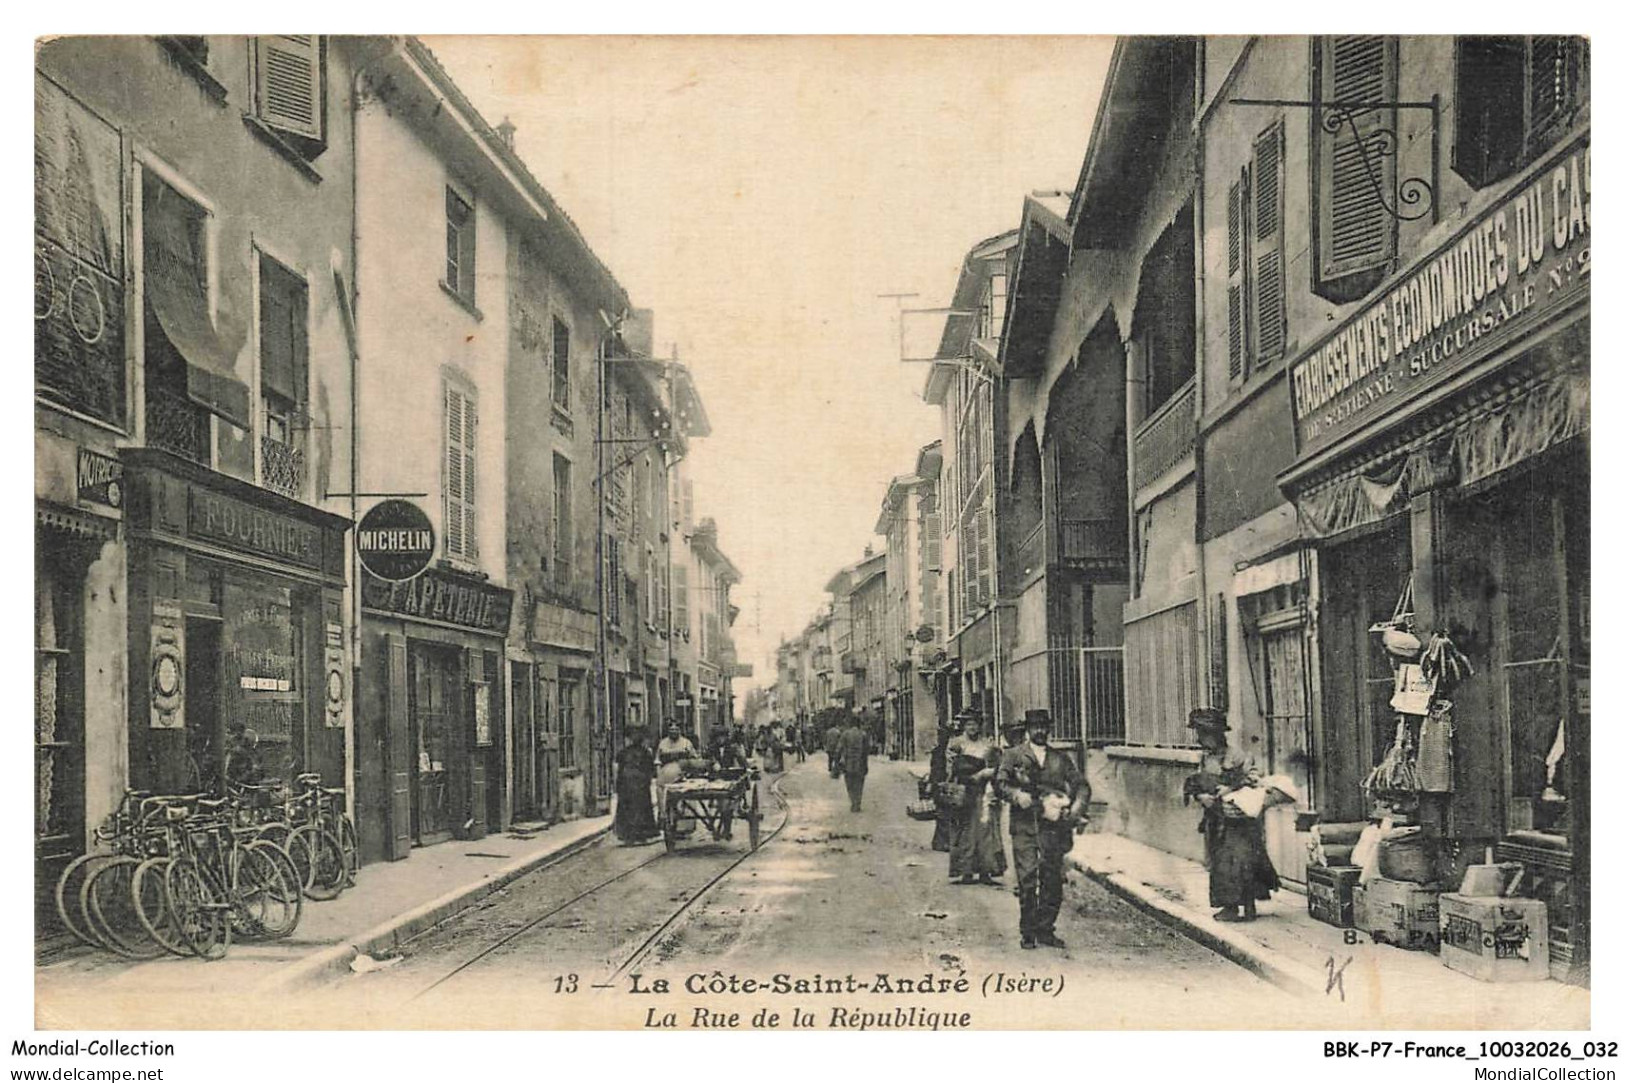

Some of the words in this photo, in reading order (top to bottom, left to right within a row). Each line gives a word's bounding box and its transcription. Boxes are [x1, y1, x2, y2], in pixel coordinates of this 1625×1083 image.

[1294, 302, 1390, 420] ETABLISSEMENTS
[1390, 210, 1509, 356] ECONOMIQUES
[1515, 182, 1544, 275] DU
[1410, 283, 1536, 377] SUCCURSALE
[360, 530, 431, 551] MICHELIN
